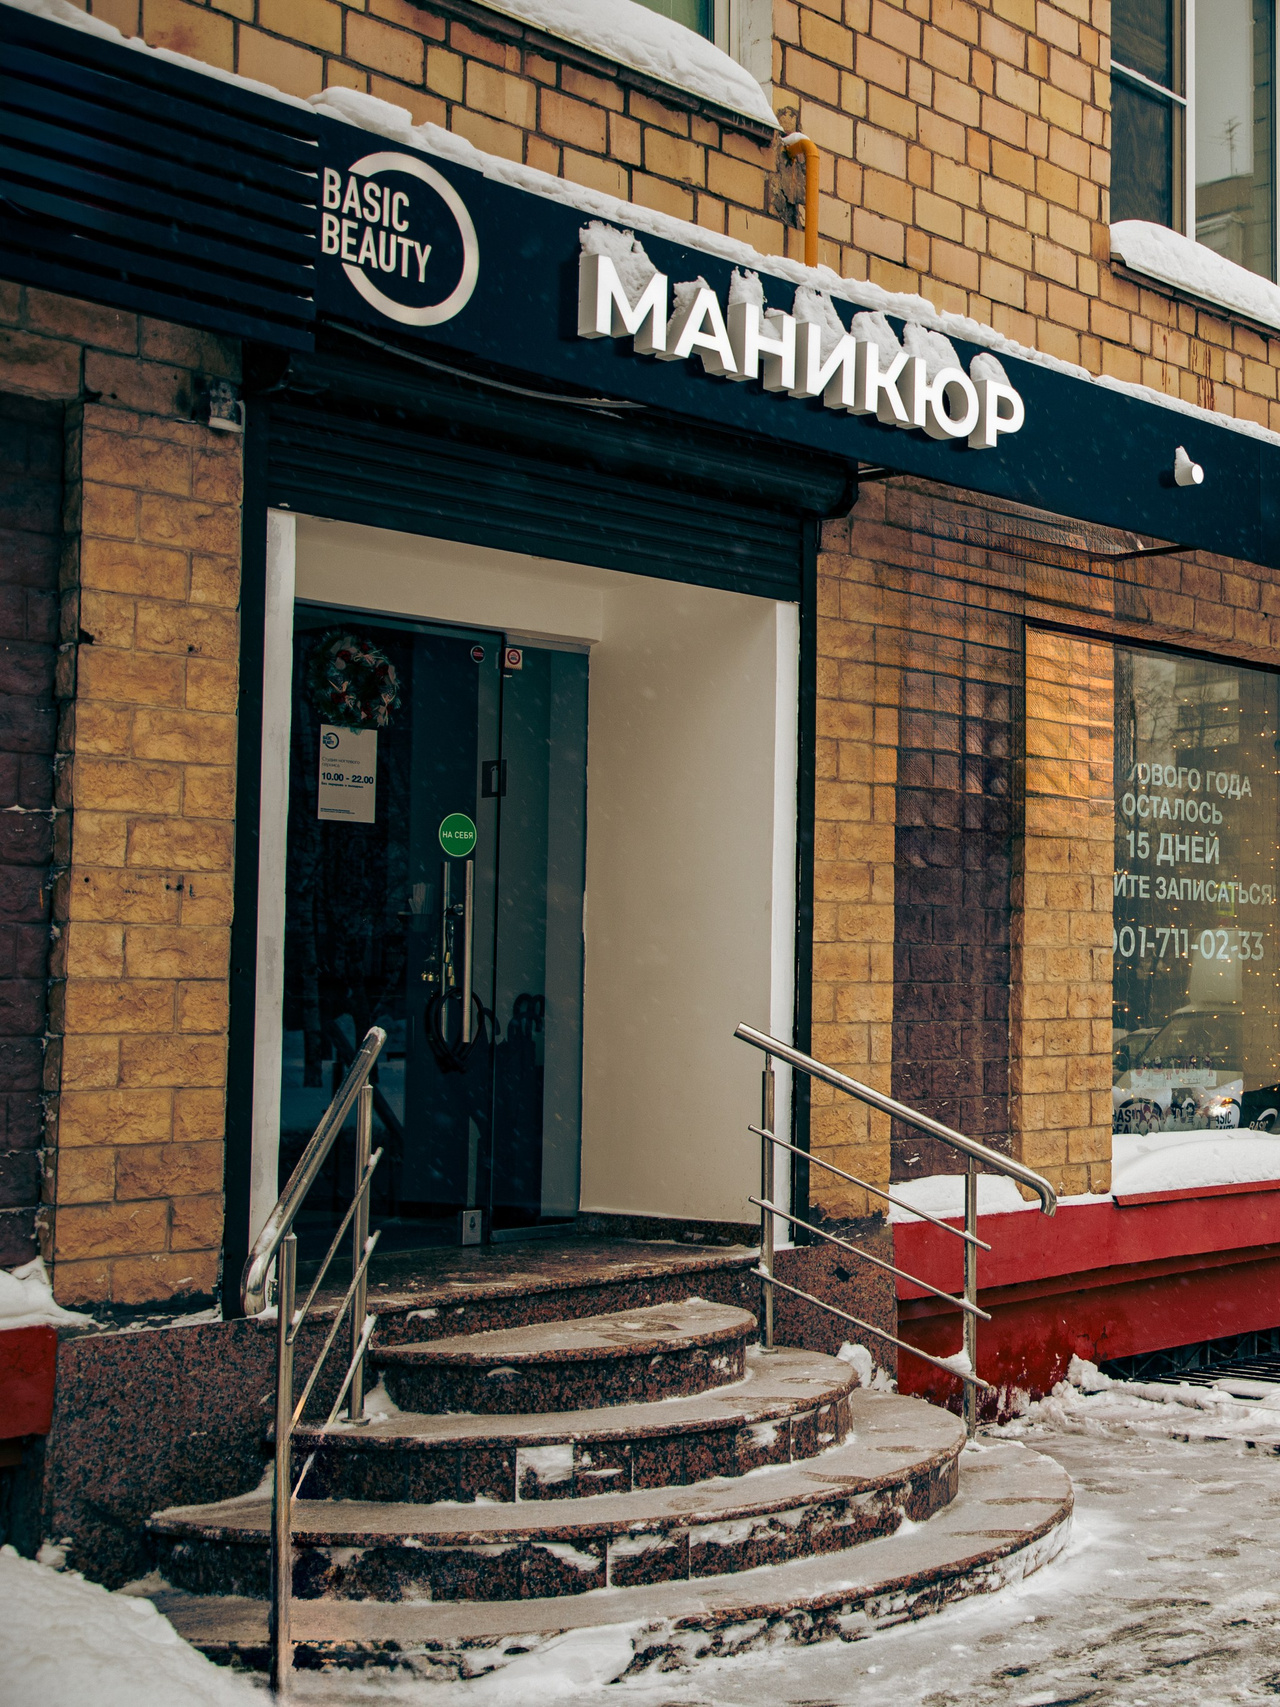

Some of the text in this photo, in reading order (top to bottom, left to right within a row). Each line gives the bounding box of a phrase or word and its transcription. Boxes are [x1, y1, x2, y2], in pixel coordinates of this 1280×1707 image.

[323, 167, 410, 232] BASIC
[321, 212, 432, 283] BEAUTY
[597, 254, 1026, 449] МАНИКЮР
[321, 772, 345, 782] 10.00
[351, 775, 375, 784] 22.00
[1128, 763, 1252, 800] ОВОГО ГОДА
[1122, 792, 1223, 825] ОСТАЛОСЬ
[454, 831, 474, 840] СЕБЯ
[1126, 831, 1220, 866] 15 ДНЕЙ
